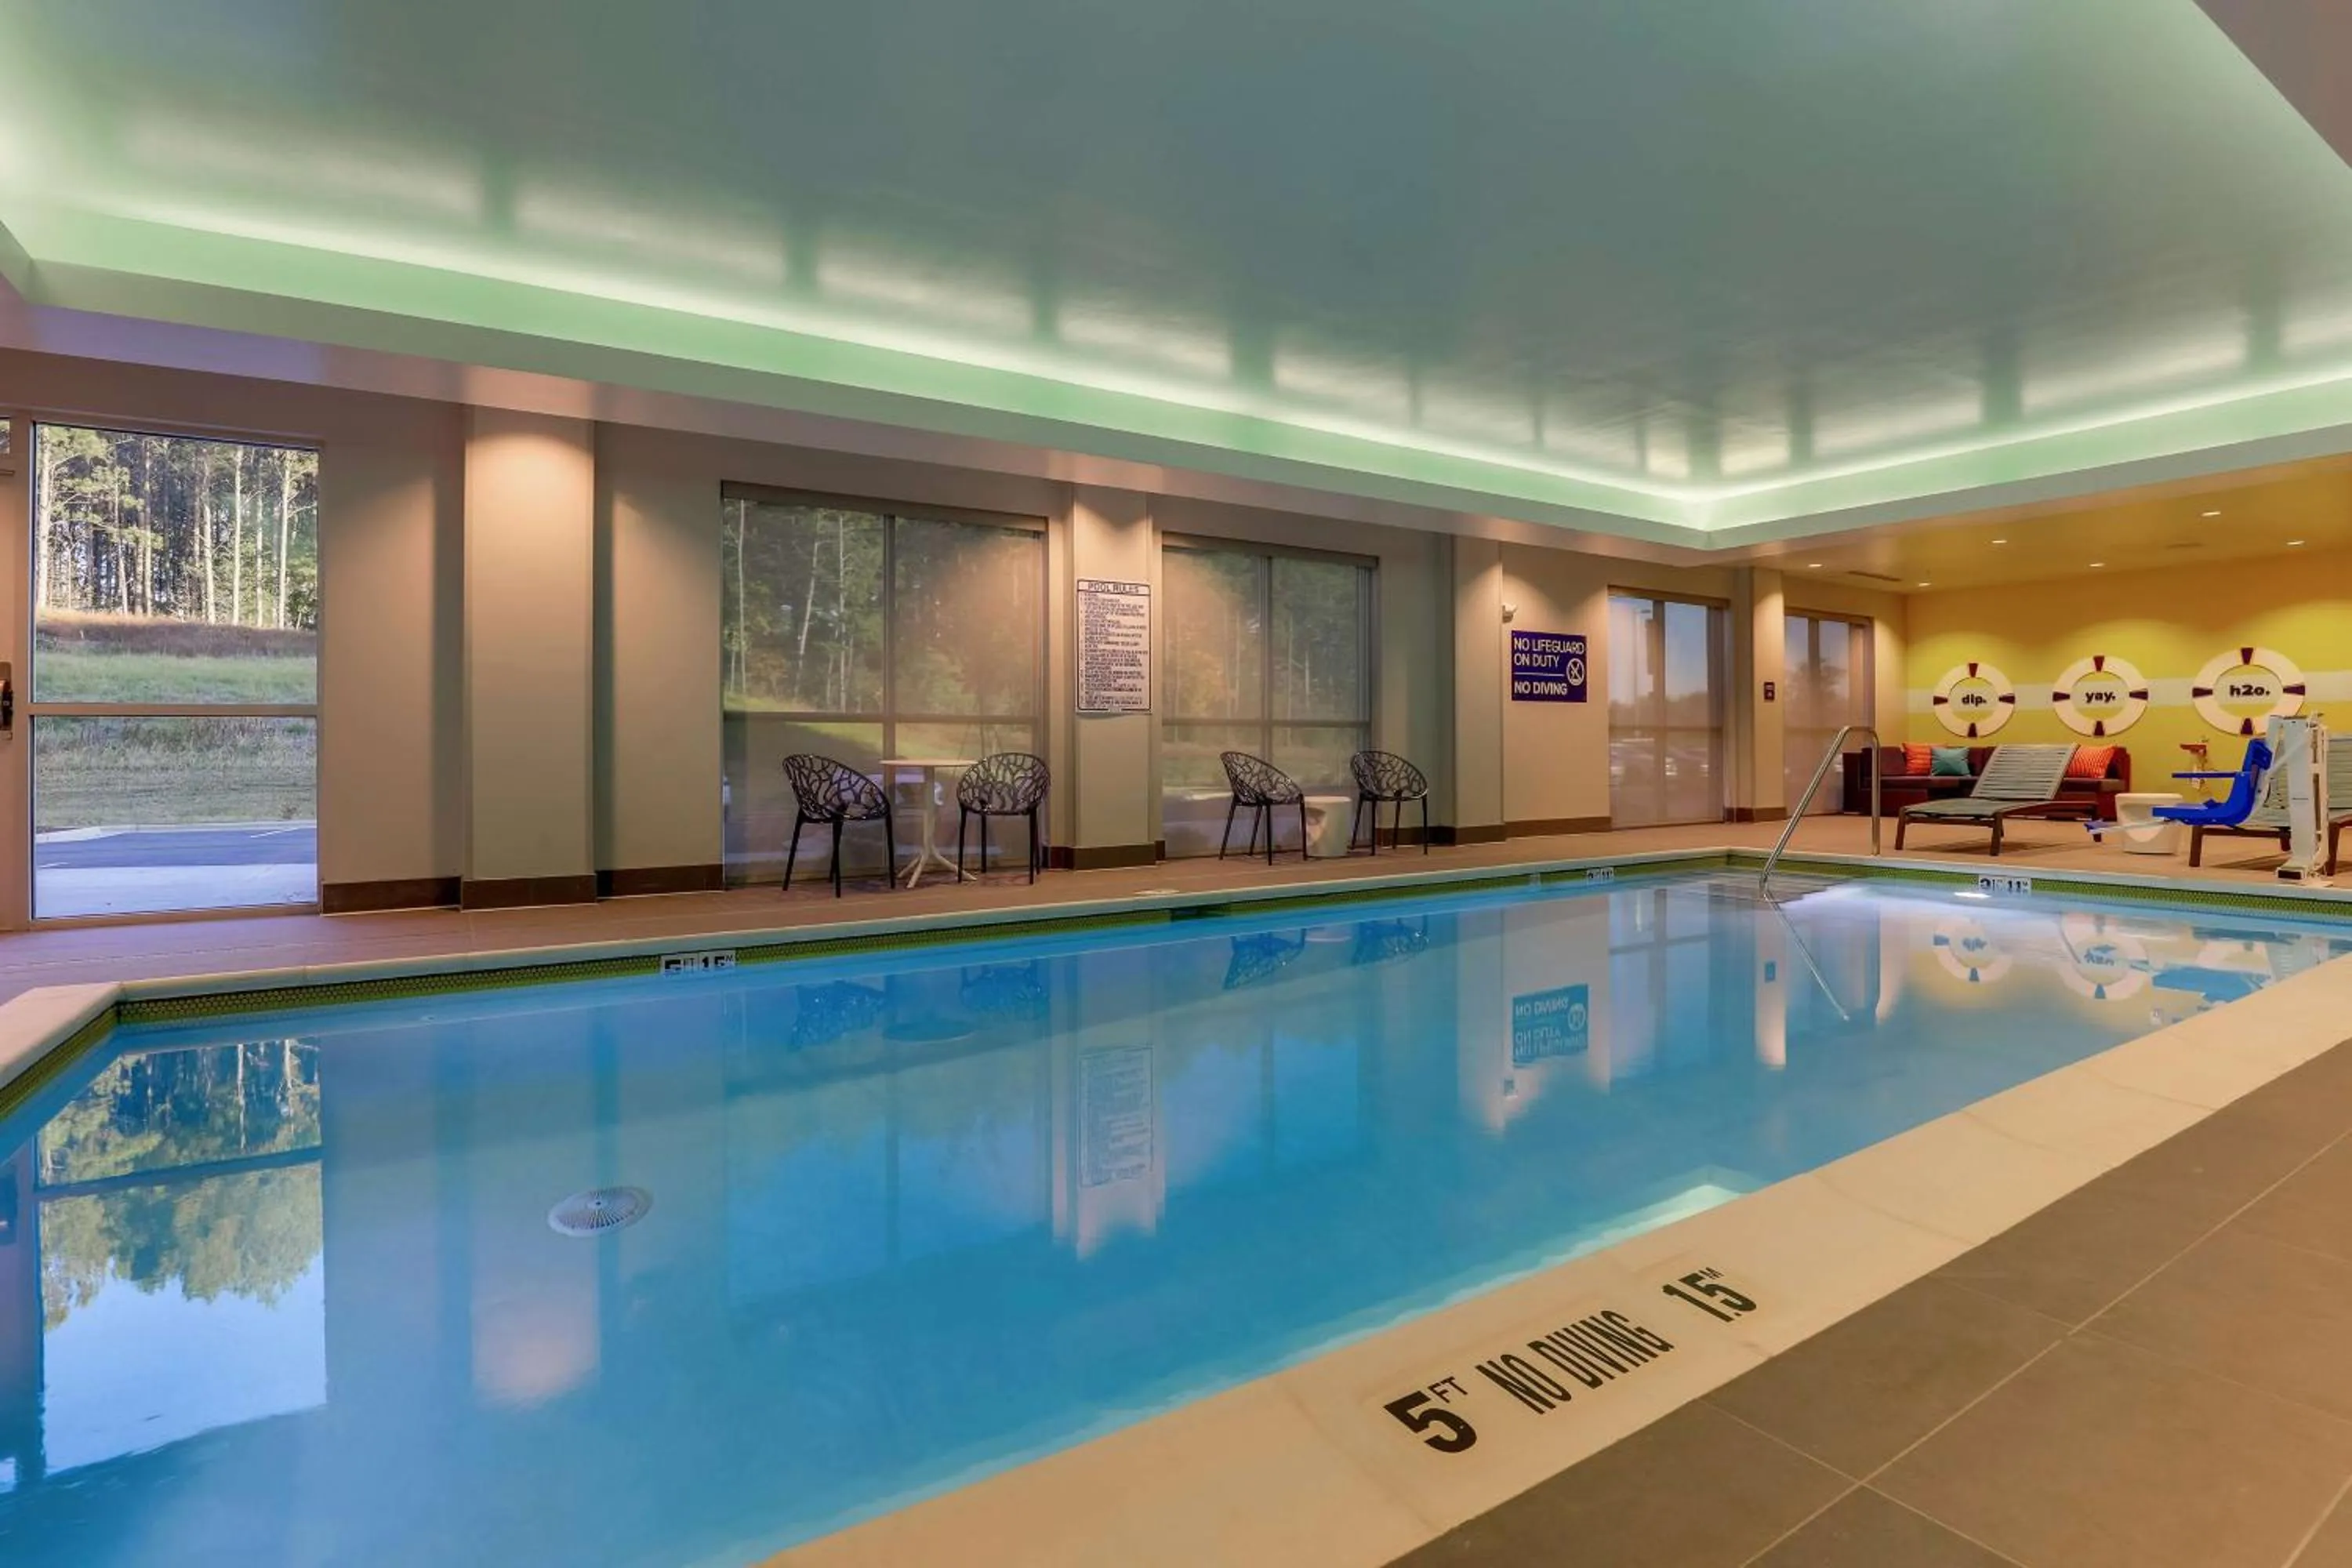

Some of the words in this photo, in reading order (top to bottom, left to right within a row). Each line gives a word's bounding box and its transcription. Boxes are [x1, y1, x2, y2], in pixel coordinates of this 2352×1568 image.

[1088, 583, 1111, 592] POOL
[1113, 584, 1138, 593] RULES
[1514, 637, 1530, 652] NO
[1533, 639, 1584, 655] LIFEGUARD
[1514, 652, 1530, 666] ON
[1533, 654, 1559, 668] DUTY
[1514, 681, 1530, 694] NO
[1534, 681, 1568, 695] DIVING
[2230, 684, 2270, 696] h2o.
[1962, 693, 1987, 707] dip.
[2085, 691, 2116, 703] yay.
[1662, 1272, 1757, 1323] 1.5
[1527, 1310, 1675, 1390] DIVING
[1428, 1376, 1468, 1404] FT
[1475, 1354, 1572, 1414] NO
[1383, 1391, 1477, 1454] 5
